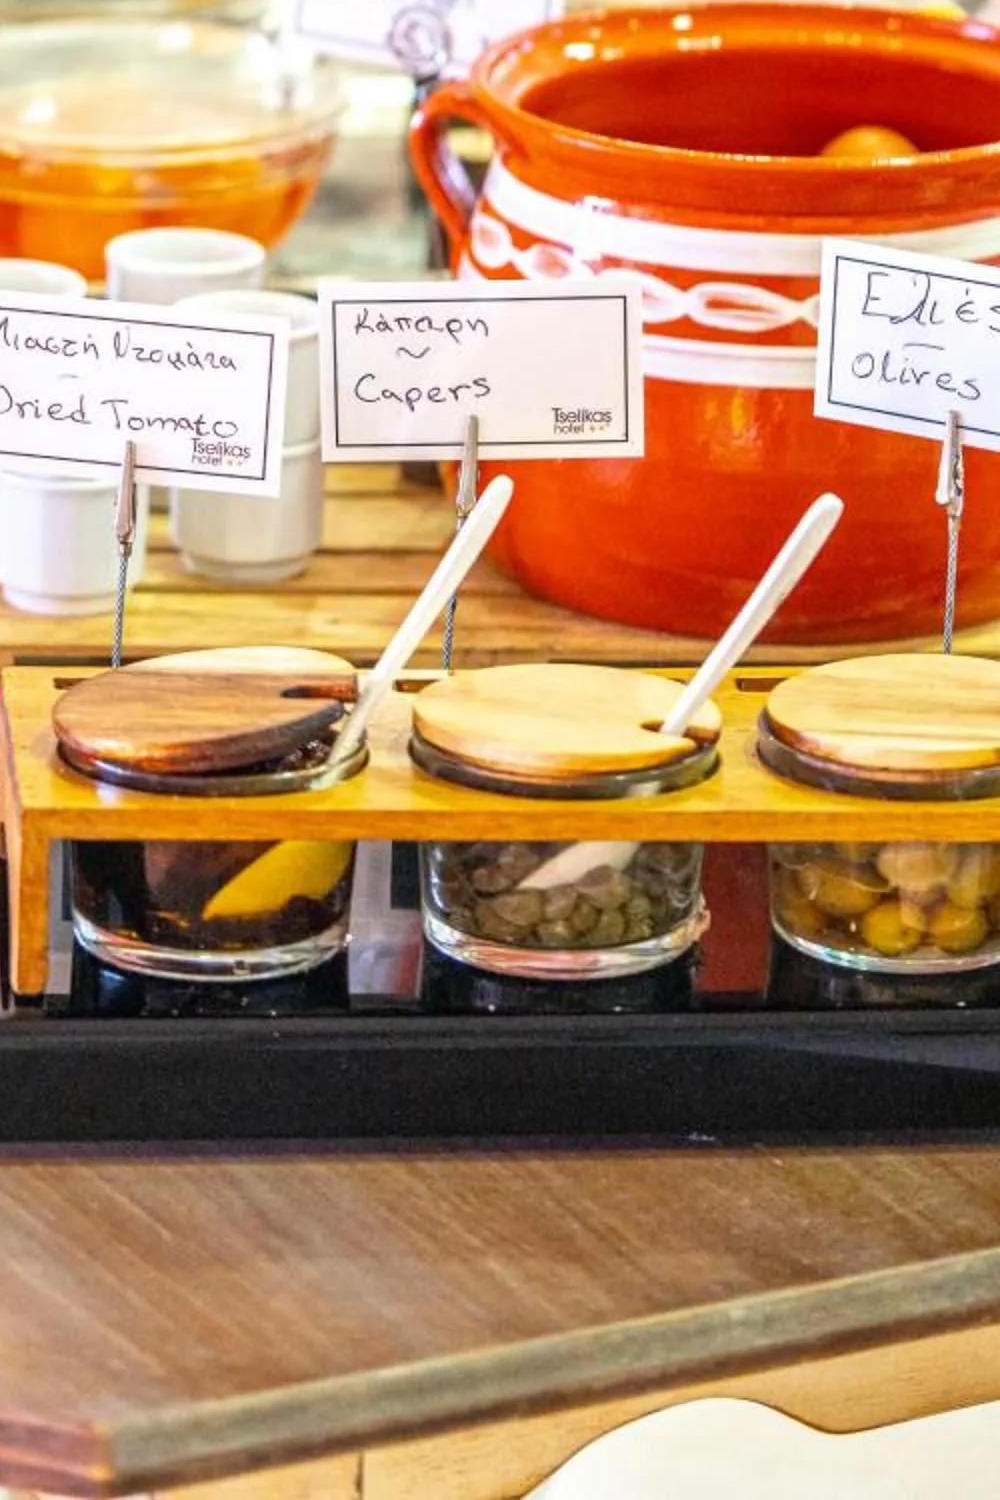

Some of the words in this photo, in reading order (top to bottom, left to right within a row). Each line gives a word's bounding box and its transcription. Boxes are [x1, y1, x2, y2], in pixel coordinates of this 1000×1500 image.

[354, 373, 491, 412] Capers
[851, 350, 982, 401] Olives
[101, 399, 238, 438] Tomato
